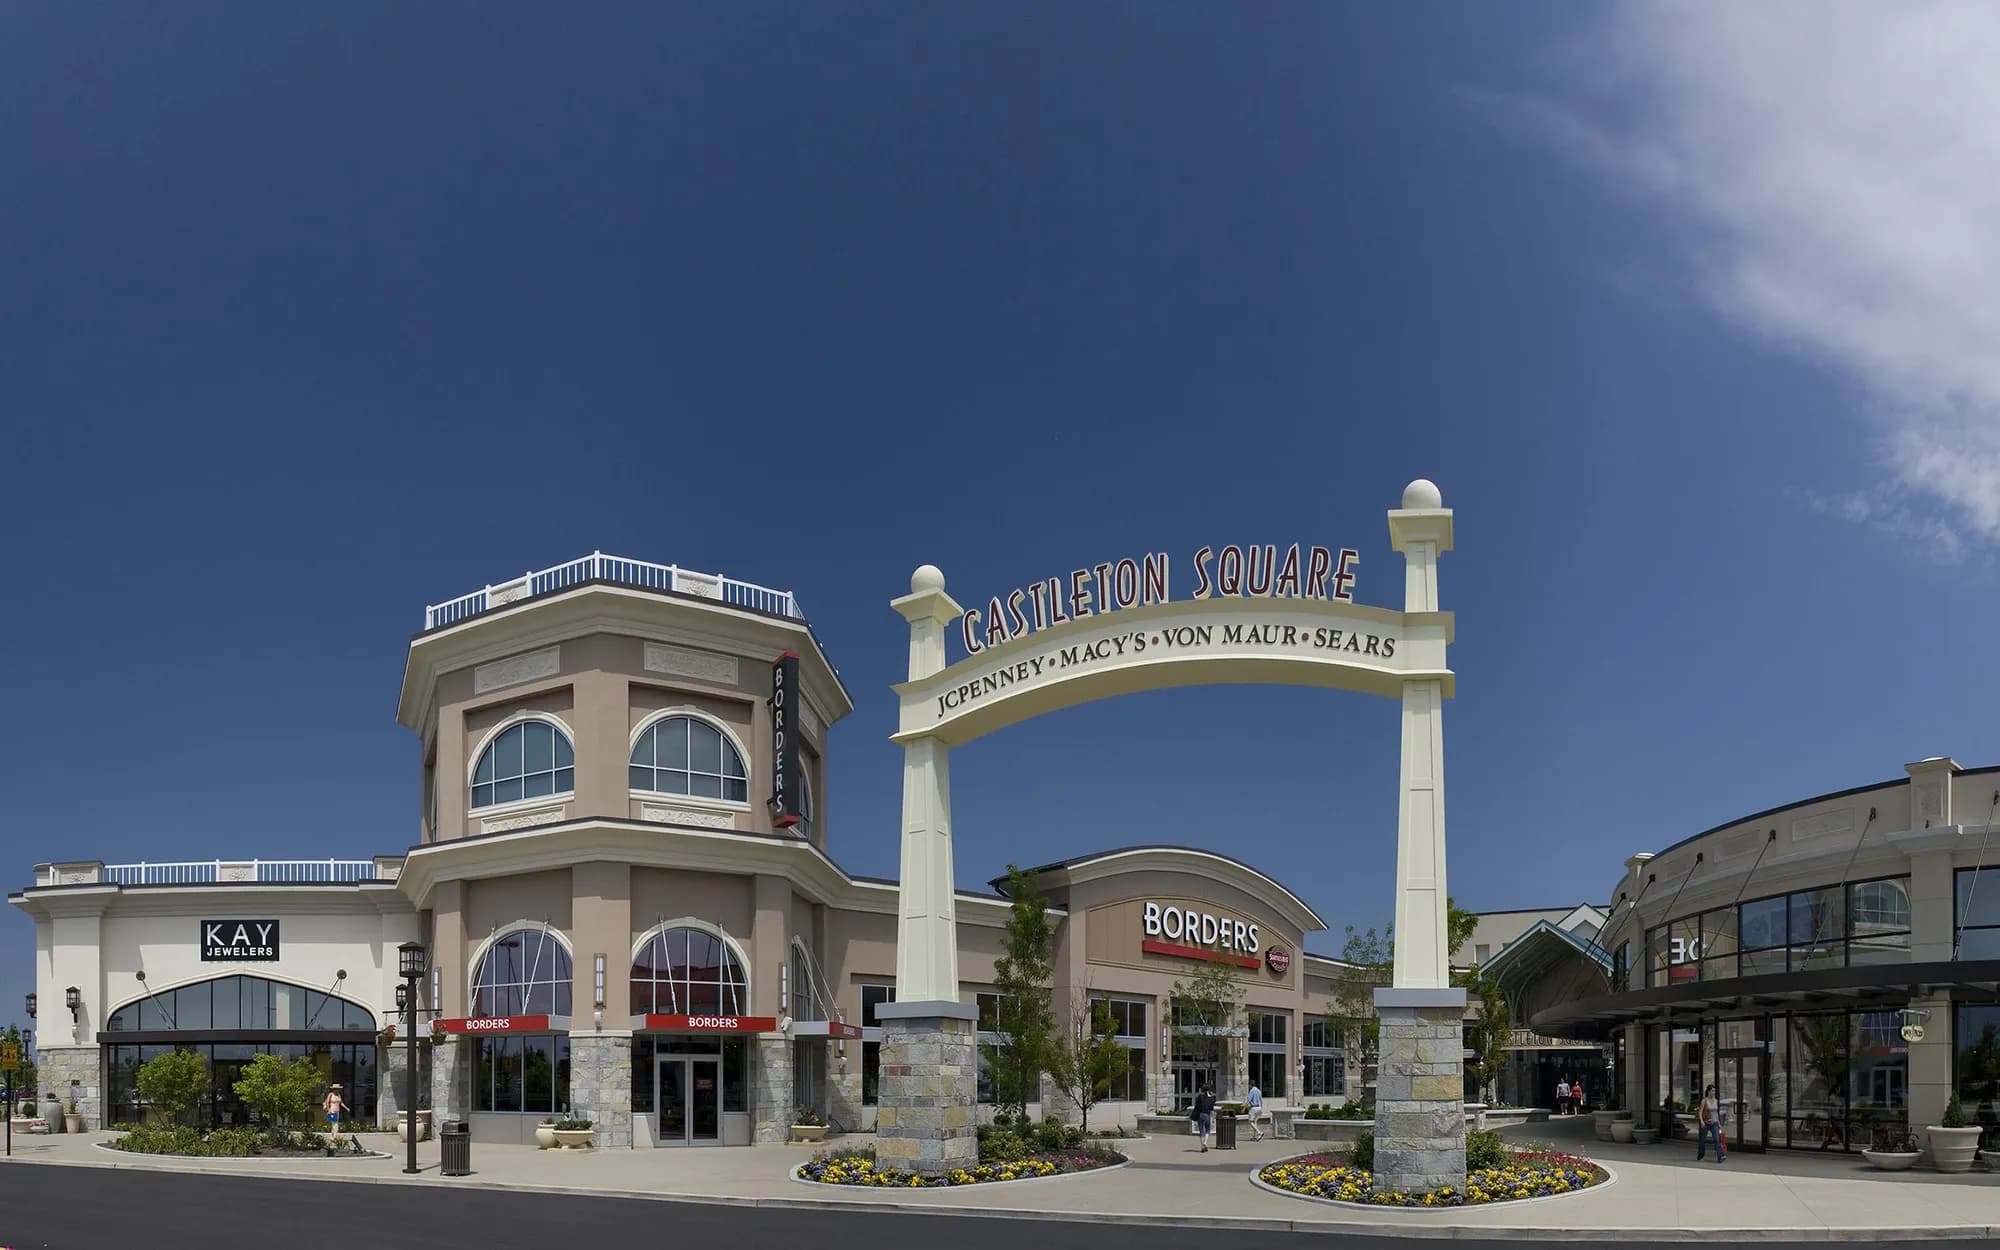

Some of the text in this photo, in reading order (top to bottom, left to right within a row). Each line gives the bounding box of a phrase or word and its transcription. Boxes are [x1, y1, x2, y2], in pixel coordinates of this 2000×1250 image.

[962, 542, 1361, 656] CASTLETON SQUARE
[937, 624, 1397, 718] JCPENNEY MACY'S VON MAUR SEARS
[774, 667, 785, 813] BORDERS
[206, 923, 273, 946] KAY
[1143, 901, 1260, 954] BORDERS
[206, 946, 274, 957] JEWELERS
[465, 1018, 511, 1031] BORDERS
[688, 1016, 738, 1029] BORDERS
